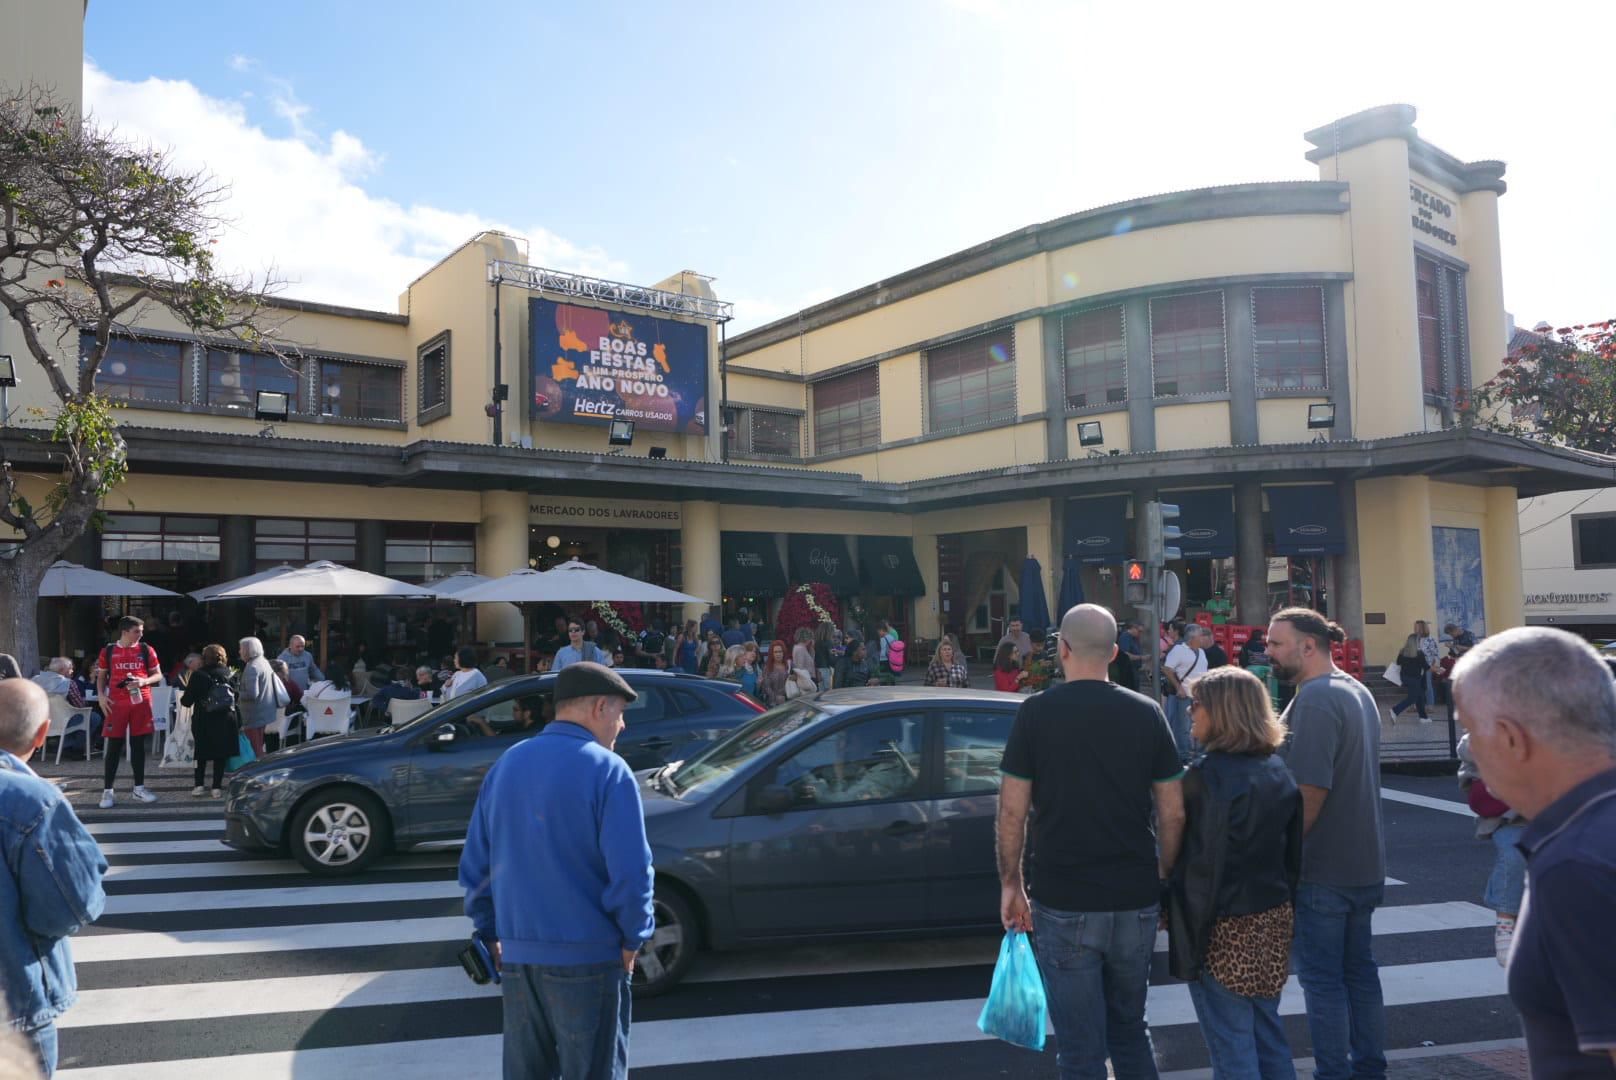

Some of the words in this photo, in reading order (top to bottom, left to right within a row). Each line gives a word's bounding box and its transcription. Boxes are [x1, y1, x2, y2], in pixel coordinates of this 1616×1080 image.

[1411, 215, 1457, 245] RADORES
[599, 336, 647, 356] BOAS
[590, 350, 656, 372] FESTAS
[592, 367, 609, 376] UM
[575, 374, 615, 391] ANO
[620, 380, 669, 397] NOVO
[574, 398, 616, 415] Hertz
[615, 408, 644, 418] CARROS
[645, 411, 673, 421] USADOS
[529, 504, 585, 516] MERCADO
[588, 507, 610, 518] DOS
[613, 509, 679, 520] LAVRADORES
